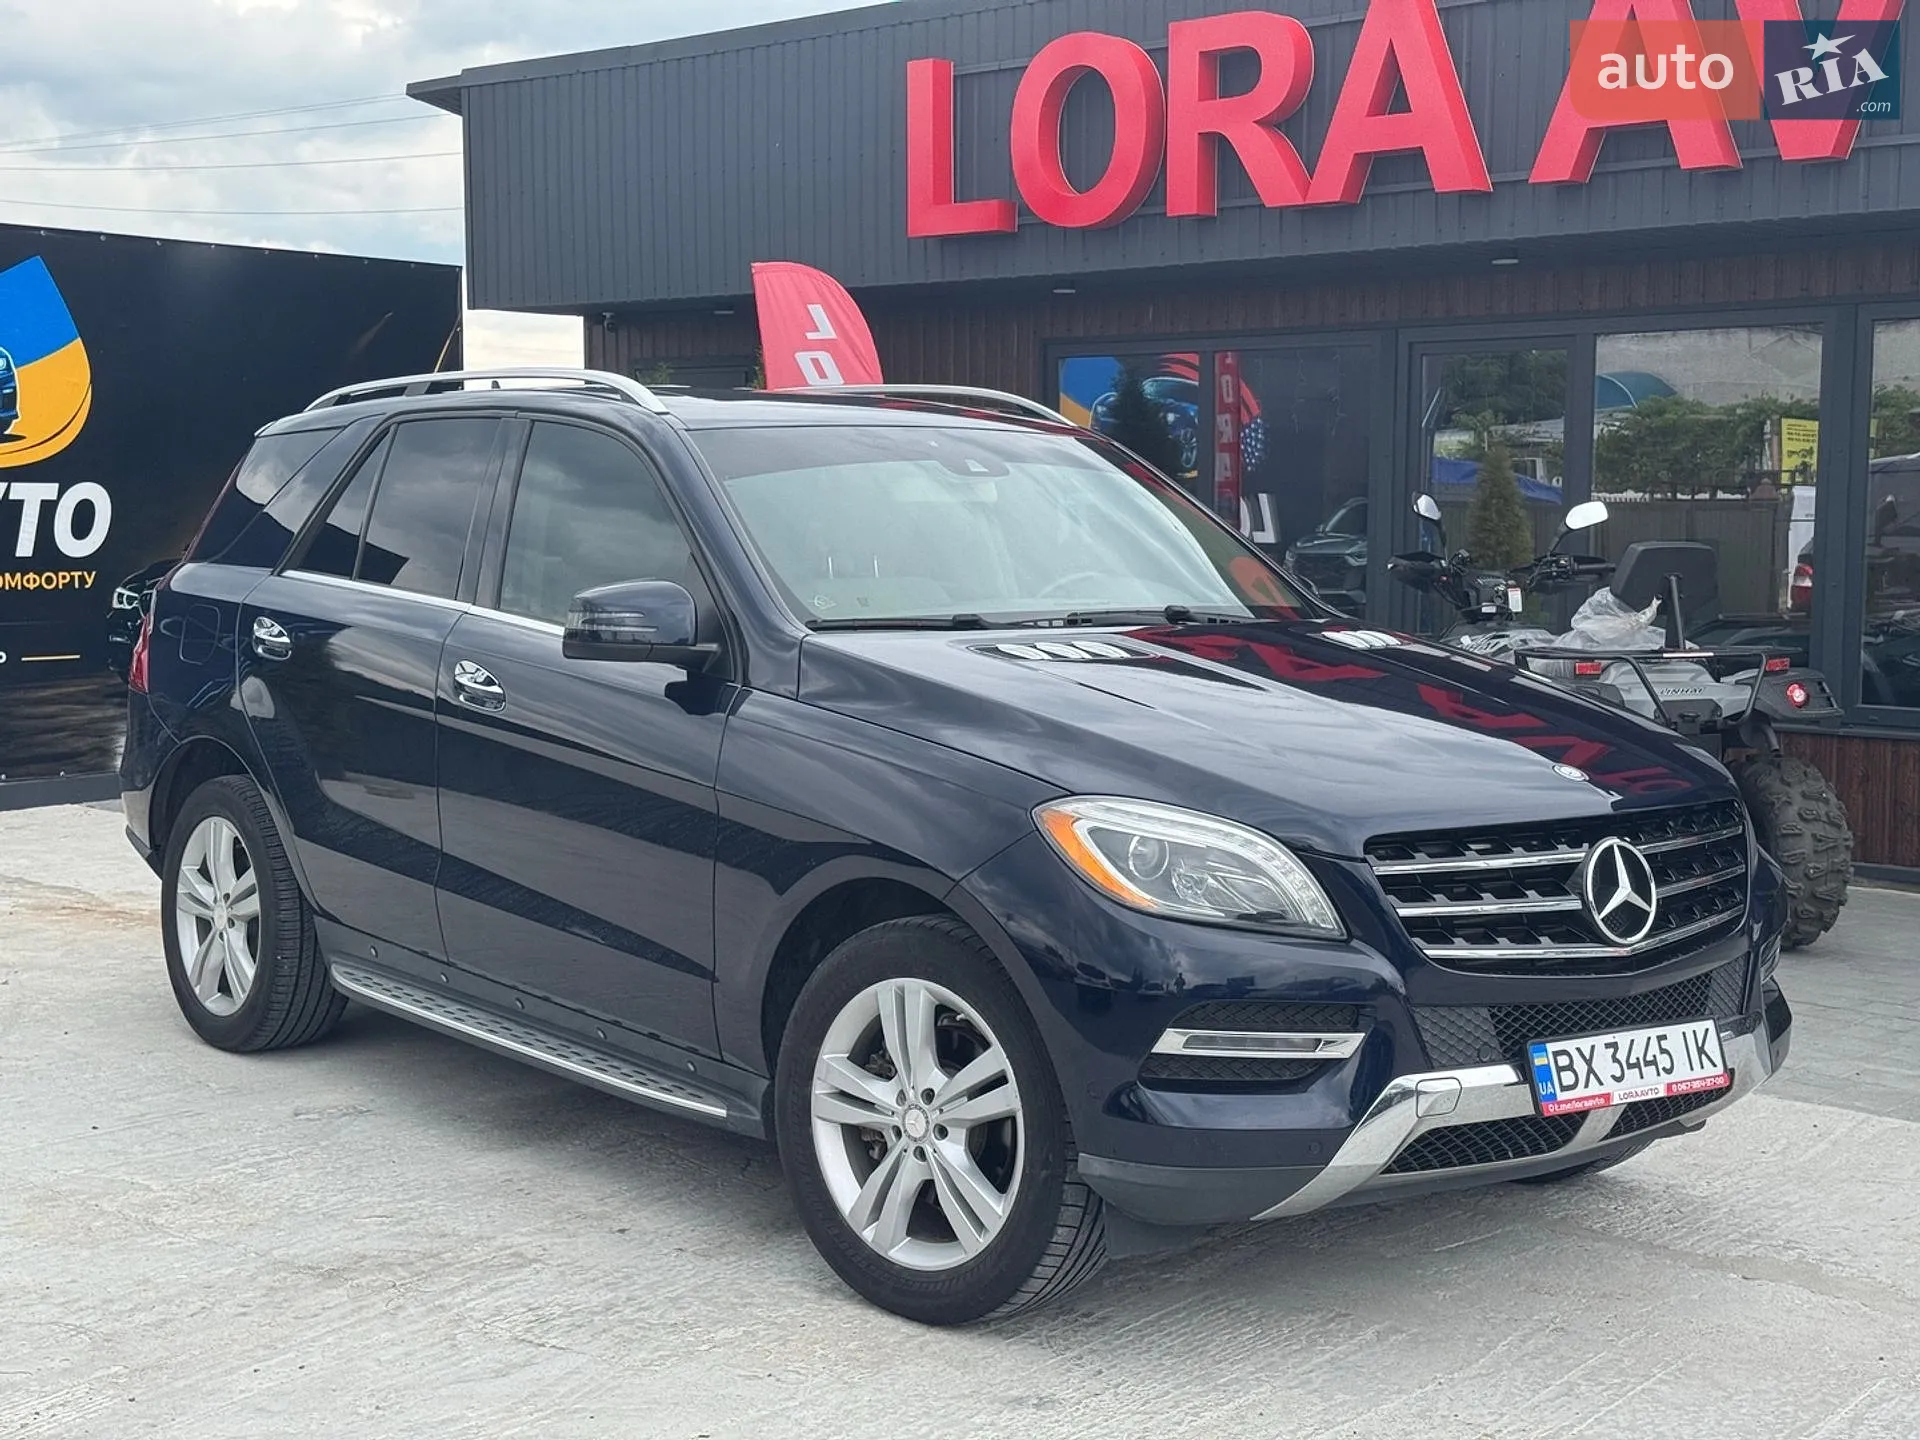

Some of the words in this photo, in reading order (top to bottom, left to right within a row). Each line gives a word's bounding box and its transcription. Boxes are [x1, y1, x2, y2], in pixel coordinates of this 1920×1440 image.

[907, 0, 1494, 239] LORA
[1540, 1081, 1556, 1096] UA
[1552, 1045, 1605, 1093] BX
[1604, 1034, 1676, 1083] 3445
[1682, 1028, 1718, 1072] IK
